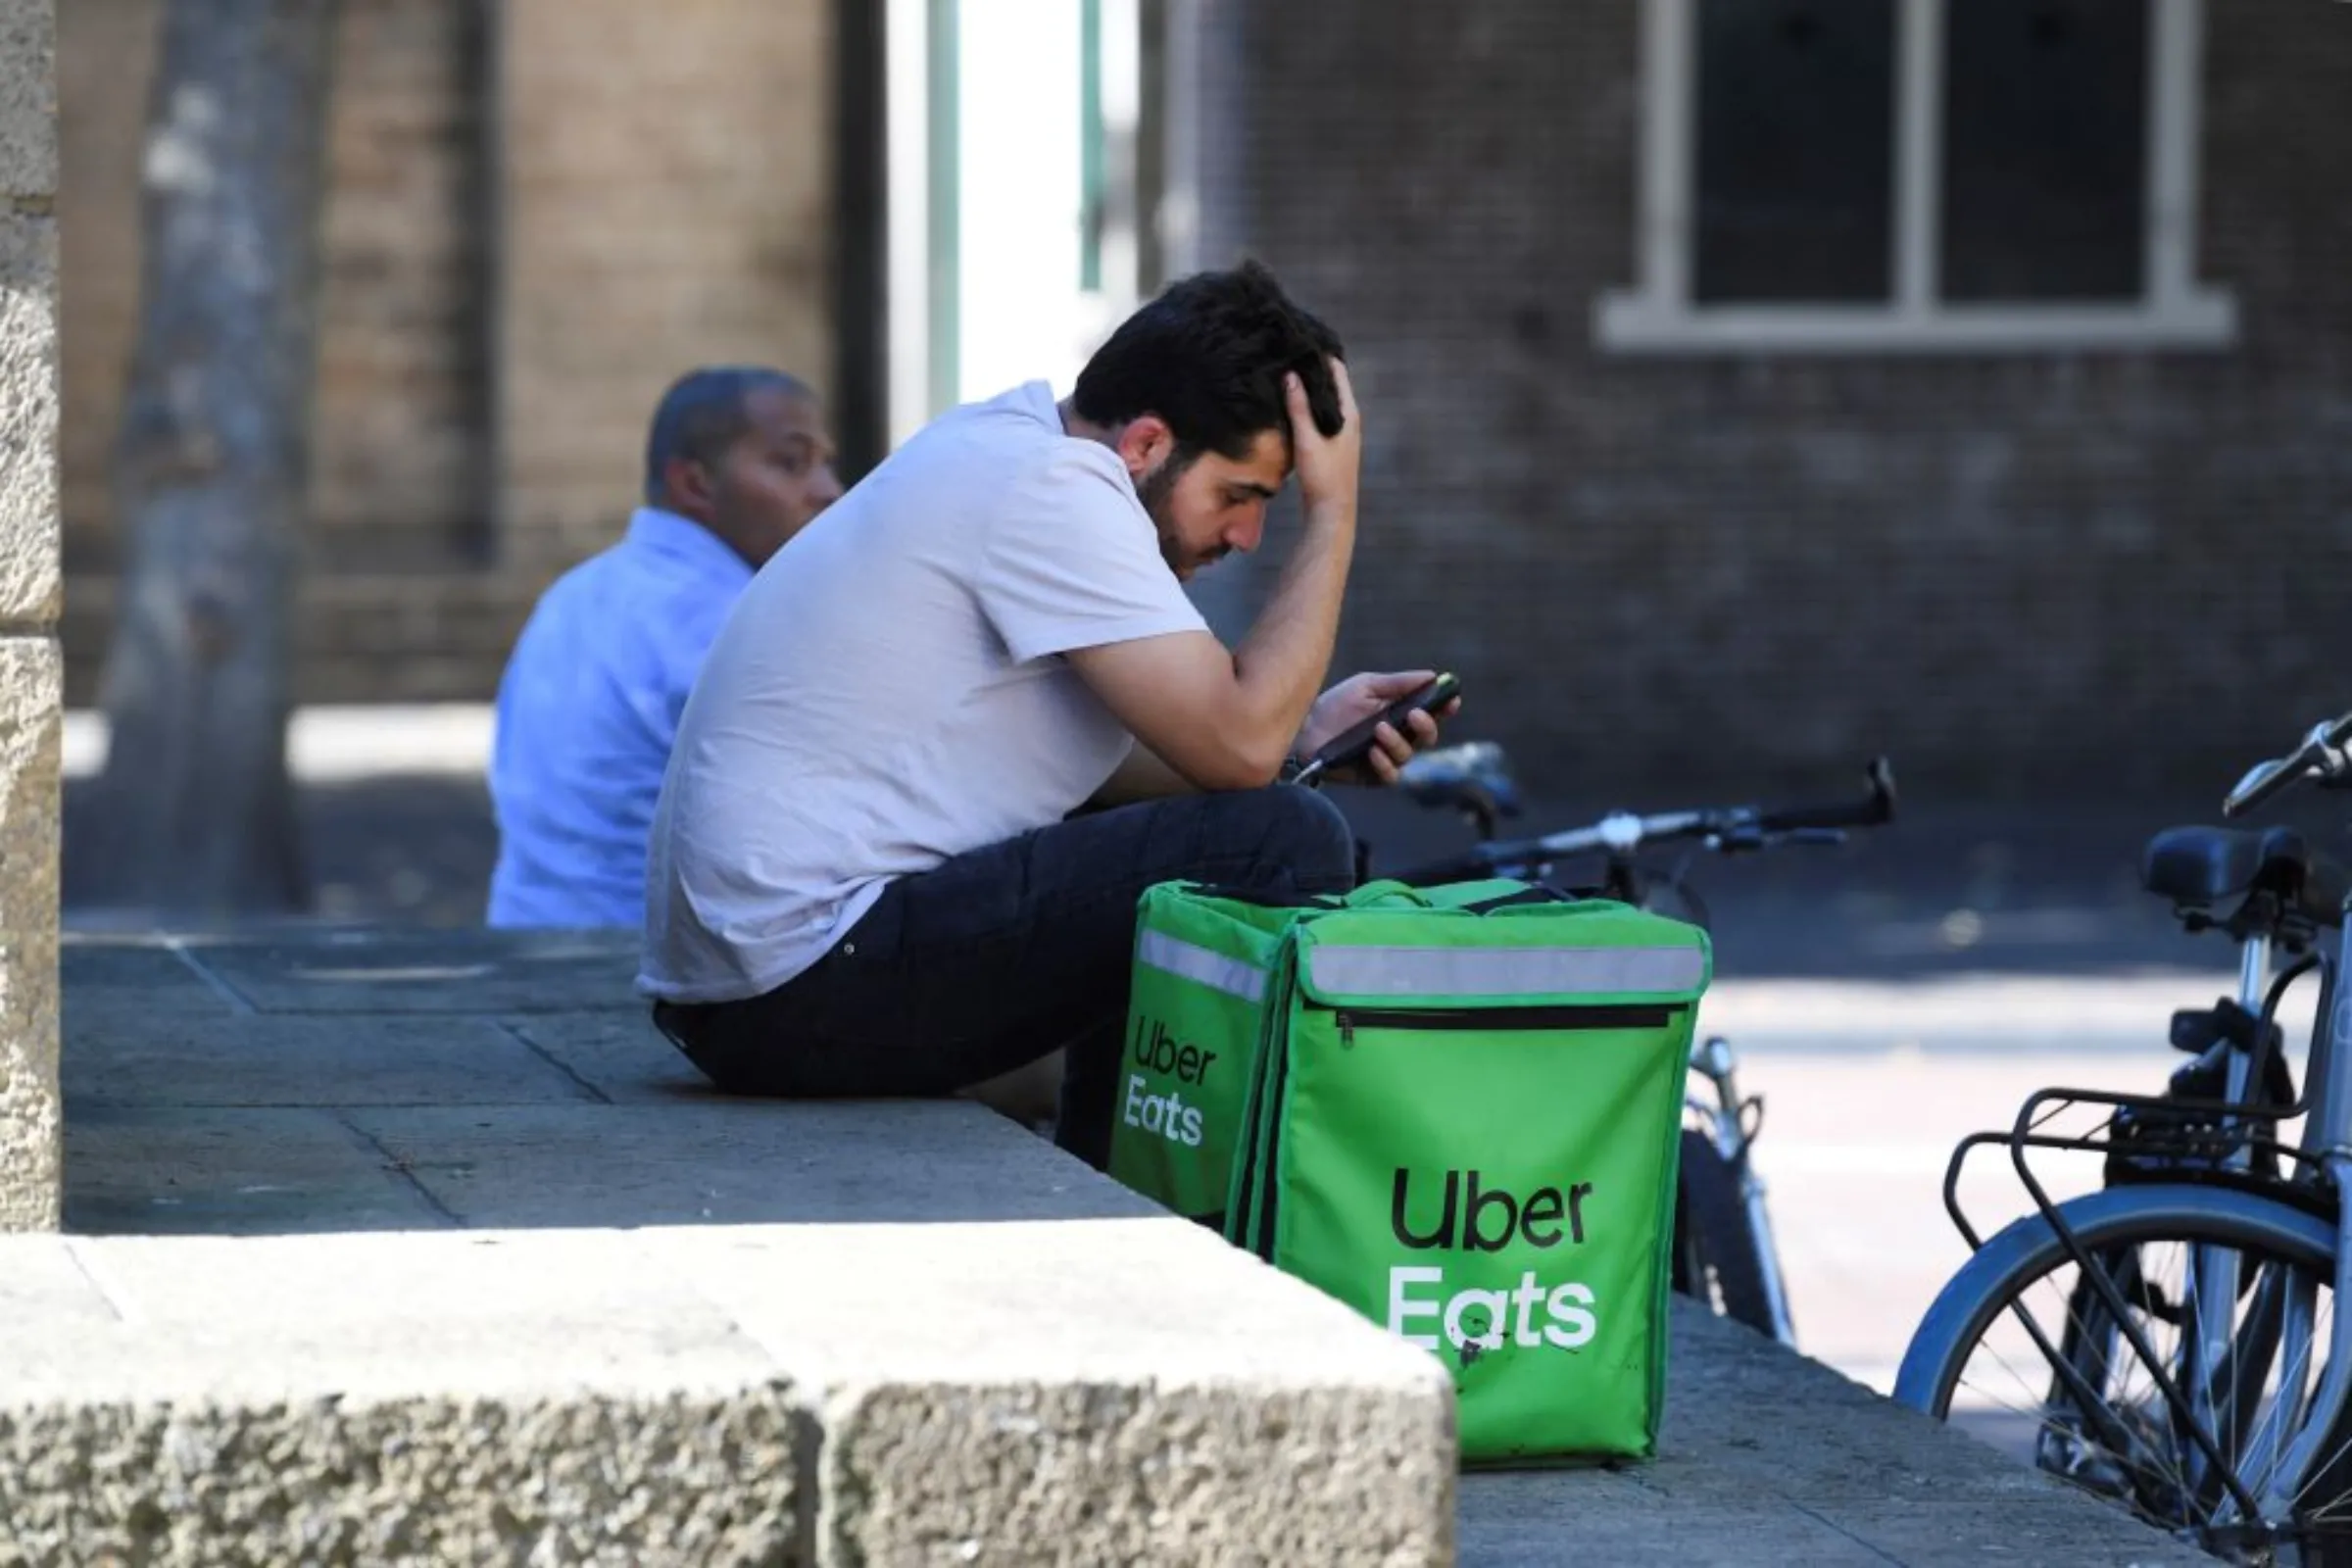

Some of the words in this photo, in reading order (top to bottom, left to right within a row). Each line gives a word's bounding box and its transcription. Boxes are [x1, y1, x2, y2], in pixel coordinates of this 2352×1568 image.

[1135, 1015, 1216, 1086] Uber
[1124, 1074, 1202, 1146] Eats
[1392, 1167, 1592, 1252] Uber
[1388, 1266, 1596, 1350] Eats
